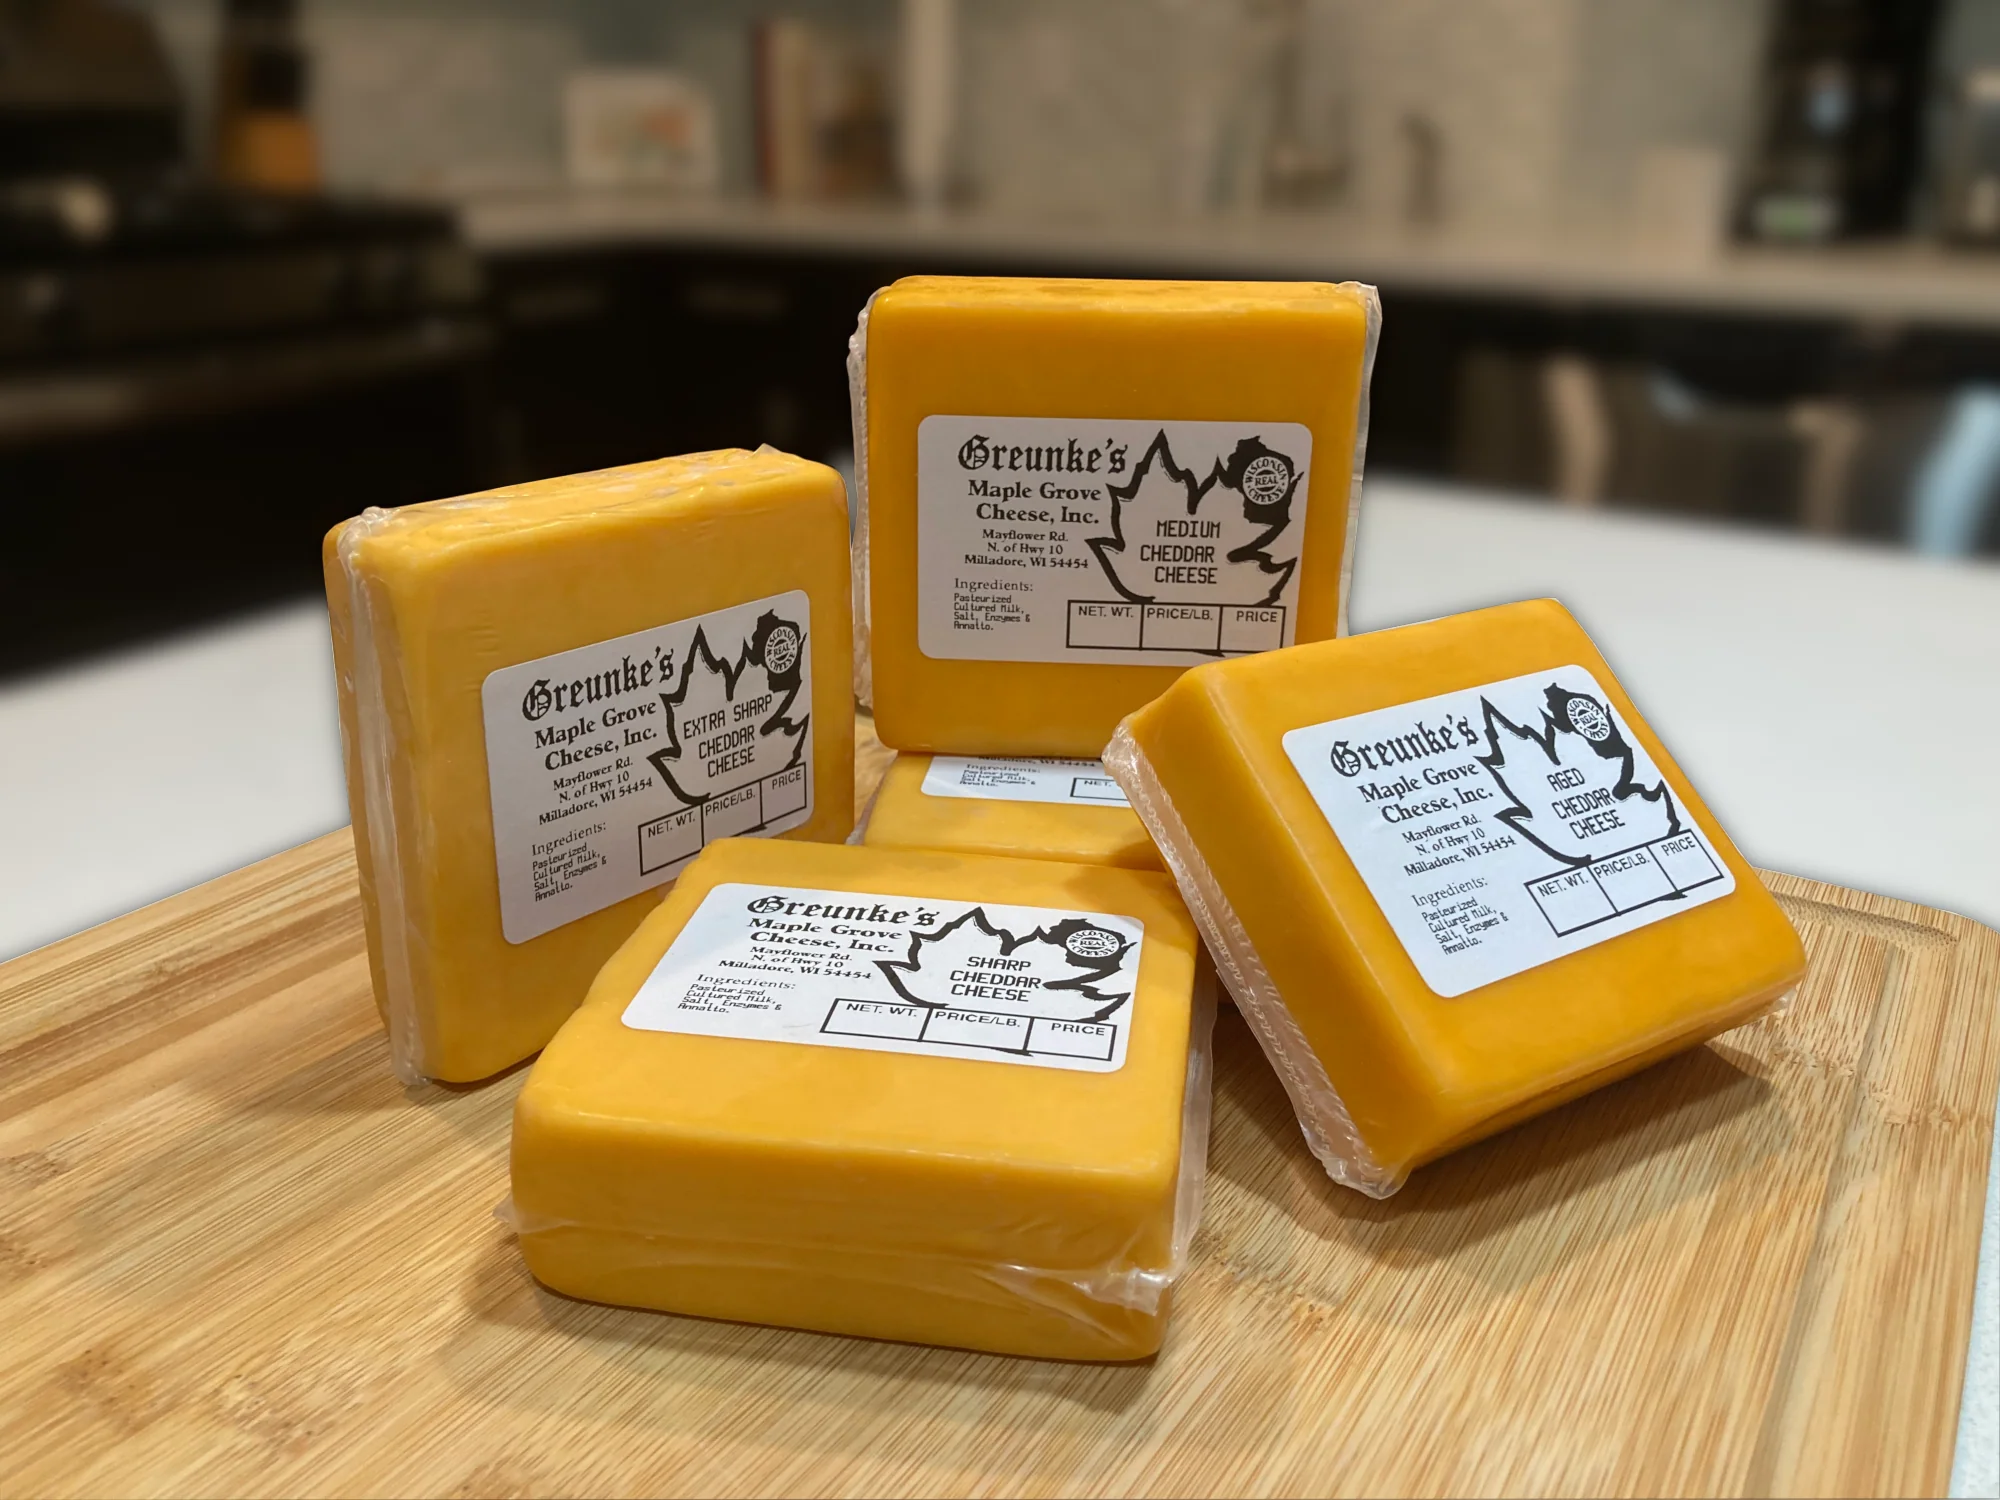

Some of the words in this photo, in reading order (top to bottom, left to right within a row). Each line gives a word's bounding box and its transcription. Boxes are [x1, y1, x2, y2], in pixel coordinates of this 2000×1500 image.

[958, 434, 1128, 473] Greunke's
[1245, 459, 1287, 483] WISCONSIN
[1255, 476, 1278, 486] REAL
[968, 479, 1032, 503] Maple
[1040, 482, 1102, 500] Grove
[1248, 487, 1284, 502] CHEESE
[976, 503, 1054, 525] Cheese,
[1060, 506, 1099, 524] Inc.
[982, 529, 1045, 542] Mayflower
[1049, 531, 1068, 541] Rd.
[1157, 520, 1220, 538] MEDIUM
[987, 543, 999, 552] N.
[1008, 543, 1017, 552] of
[1020, 544, 1044, 554] Hwy
[1049, 545, 1063, 554] 10
[1140, 545, 1214, 563] CHEDDAR
[965, 555, 1026, 567] Milladore,
[1030, 557, 1046, 567] WI
[1050, 558, 1088, 568] 54454
[954, 578, 1033, 592] Ingredients:
[1154, 567, 1218, 584] CHEESE
[954, 593, 1011, 603] Pasteurized
[954, 602, 996, 611] Cultured
[1000, 605, 1025, 614] Milk,
[954, 612, 978, 621] Salt,
[985, 614, 1020, 623] Enzymes
[1078, 606, 1106, 617] NET.
[1111, 608, 1134, 618] WT.
[1147, 609, 1213, 621] PRICE/LB.
[1236, 611, 1277, 622] PRICE
[954, 621, 994, 630] Annatto.
[767, 629, 796, 657] WISCONSIN
[774, 643, 790, 657] REAL
[770, 652, 795, 671] CHEESE
[522, 646, 674, 721] Greunke's
[535, 717, 596, 748] Maple
[602, 703, 656, 727] Grove
[684, 710, 725, 739] EXTRA
[734, 694, 772, 722] SHARP
[1580, 713, 1598, 725] REAL
[545, 739, 619, 770] Cheese,
[624, 727, 657, 746] Inc.
[699, 725, 755, 759] CHEDDAR
[1331, 714, 1479, 777] Greunke's
[708, 746, 755, 778] CHEESE
[553, 766, 612, 790] Mayflower
[616, 757, 633, 770] Rd.
[1357, 776, 1422, 803] Maple
[1423, 764, 1479, 785] Grove
[1547, 768, 1585, 792] AGED
[560, 791, 570, 803] N.
[575, 786, 586, 797] of
[590, 780, 612, 793] Hwy
[617, 771, 630, 783] 10
[539, 800, 598, 825] Milladore,
[600, 790, 615, 803] WI
[619, 777, 652, 797] 54454
[648, 820, 672, 837] NET.
[676, 811, 695, 827] WT.
[705, 789, 756, 815] PRICE/LB.
[772, 770, 801, 789] PRICE
[1381, 797, 1457, 824] Cheese,
[1454, 787, 1494, 804] Inc.
[1552, 787, 1613, 819] CHEDDAR
[1402, 821, 1461, 843] Mayflower
[1461, 814, 1482, 826] Rd.
[1569, 809, 1625, 839] CHEESE
[532, 822, 606, 856] Ingredients:
[1415, 844, 1431, 856] N.
[1432, 839, 1444, 851] of
[1444, 835, 1470, 846] Hwy
[1471, 828, 1485, 840] 10
[533, 843, 587, 871] Pasteurized
[533, 861, 573, 881] Cultured
[578, 850, 600, 864] Milk,
[1404, 855, 1465, 876] Milladore,
[1461, 845, 1481, 858] WI
[1480, 835, 1517, 853] 54454
[1538, 881, 1567, 897] NET.
[1564, 872, 1589, 887] WT.
[1594, 853, 1650, 878] PRICE/LB.
[1662, 836, 1695, 856] PRICE
[534, 877, 555, 891] Salt,
[564, 862, 597, 880] Enzymes
[601, 856, 607, 864] &
[535, 882, 573, 902] Annatto.
[1411, 877, 1488, 907] Ingredients:
[747, 896, 940, 926] Greunke's
[1421, 897, 1478, 922] Pasteurized
[1428, 913, 1470, 933] Cultured
[1472, 905, 1497, 918] Milk,
[747, 918, 823, 933] Maple
[831, 925, 902, 939] Grove
[1069, 931, 1116, 945] WISCONSIN
[1435, 930, 1461, 944] Salt,
[1463, 917, 1499, 934] Enzymes
[1500, 912, 1509, 922] &
[750, 932, 840, 949] Cheese,
[848, 939, 894, 952] Inc.
[1073, 946, 1114, 955] CHEESE
[1442, 936, 1482, 955] Annatto.
[750, 947, 826, 959] Mayflower
[828, 953, 852, 961] Rd.
[791, 958, 822, 967] Hwy
[967, 956, 1031, 971] SHARP
[718, 960, 794, 973] Milladore,
[800, 967, 819, 975] WI
[823, 969, 871, 980] 54454
[950, 971, 1041, 989] CHEDDAR
[690, 984, 765, 995] Pasteurized
[697, 974, 797, 990] Ingredients:
[951, 984, 1030, 1002] CHEESE
[678, 1003, 729, 1013] Annatto.
[682, 997, 713, 1006] Salt,
[722, 1000, 769, 1009] Enzymes
[686, 991, 741, 1001] Cultured
[746, 994, 776, 1004] Milk,
[846, 1003, 882, 1014] NET.
[890, 1006, 916, 1017] WT.
[934, 1011, 1020, 1028] PRICE/LB.
[1050, 1022, 1105, 1036] PRICE
